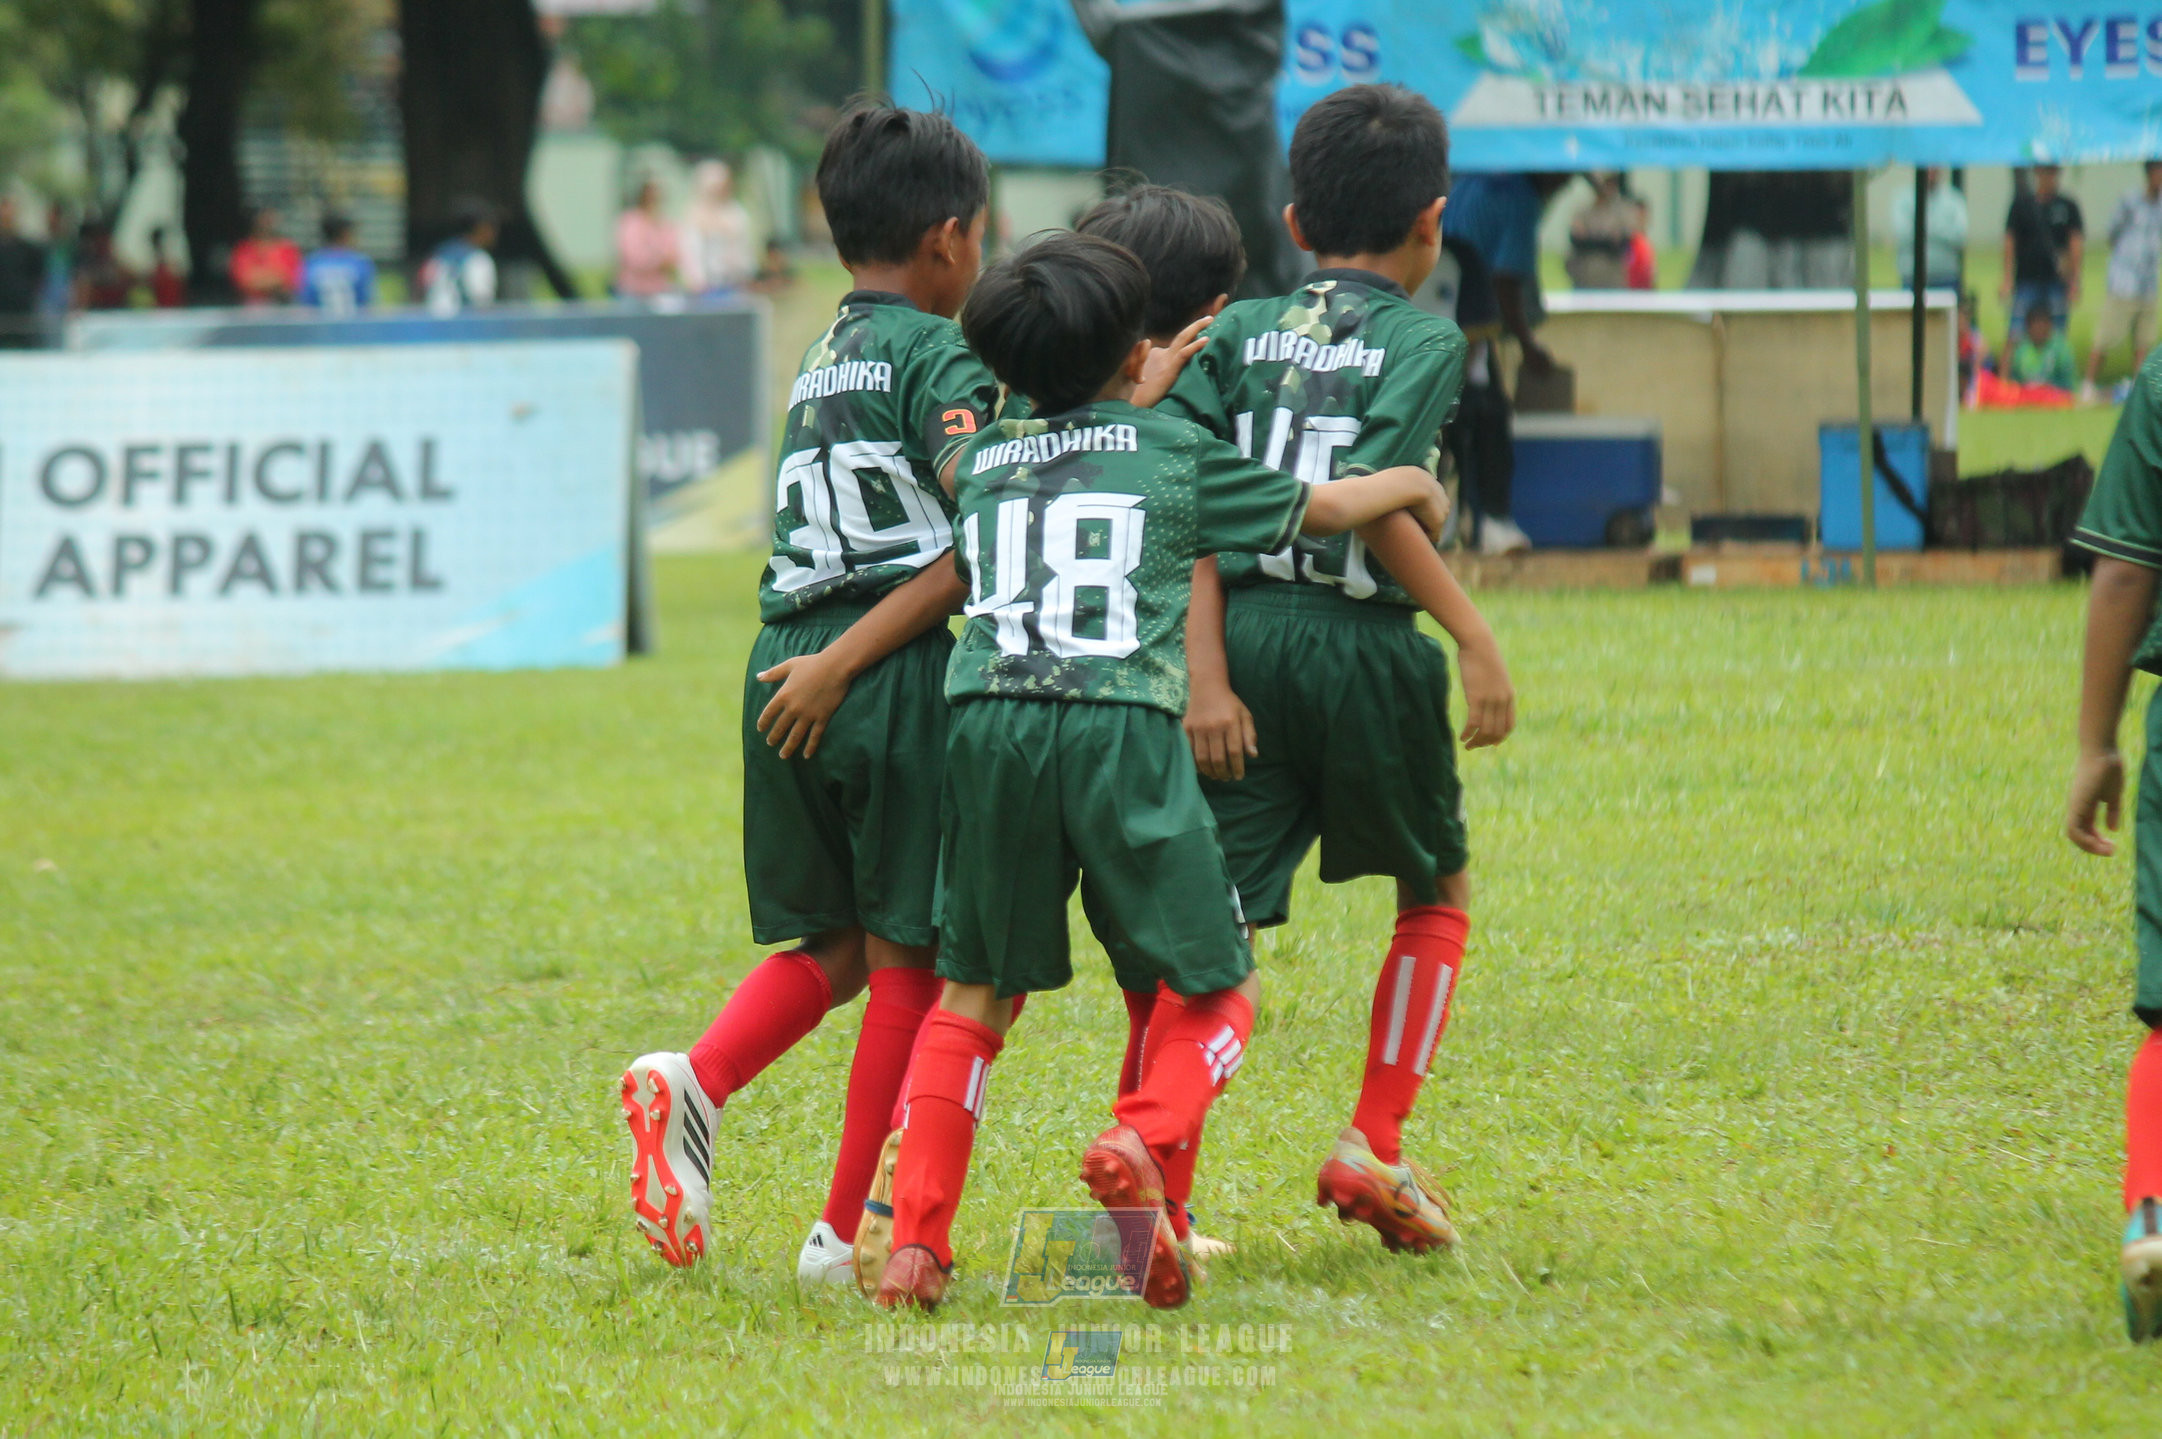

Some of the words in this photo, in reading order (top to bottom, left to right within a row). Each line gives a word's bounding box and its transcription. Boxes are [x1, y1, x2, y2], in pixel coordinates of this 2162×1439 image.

[1536, 86, 1667, 119] TEMAN
[1682, 85, 1804, 119] SEHAT
[1822, 84, 1908, 118] KITA
[38, 438, 457, 508] OFFICIAL
[972, 424, 1138, 475] WIRADHIKA
[769, 440, 953, 592] 39
[34, 528, 446, 598] APPAREL
[963, 491, 1147, 659] 48
